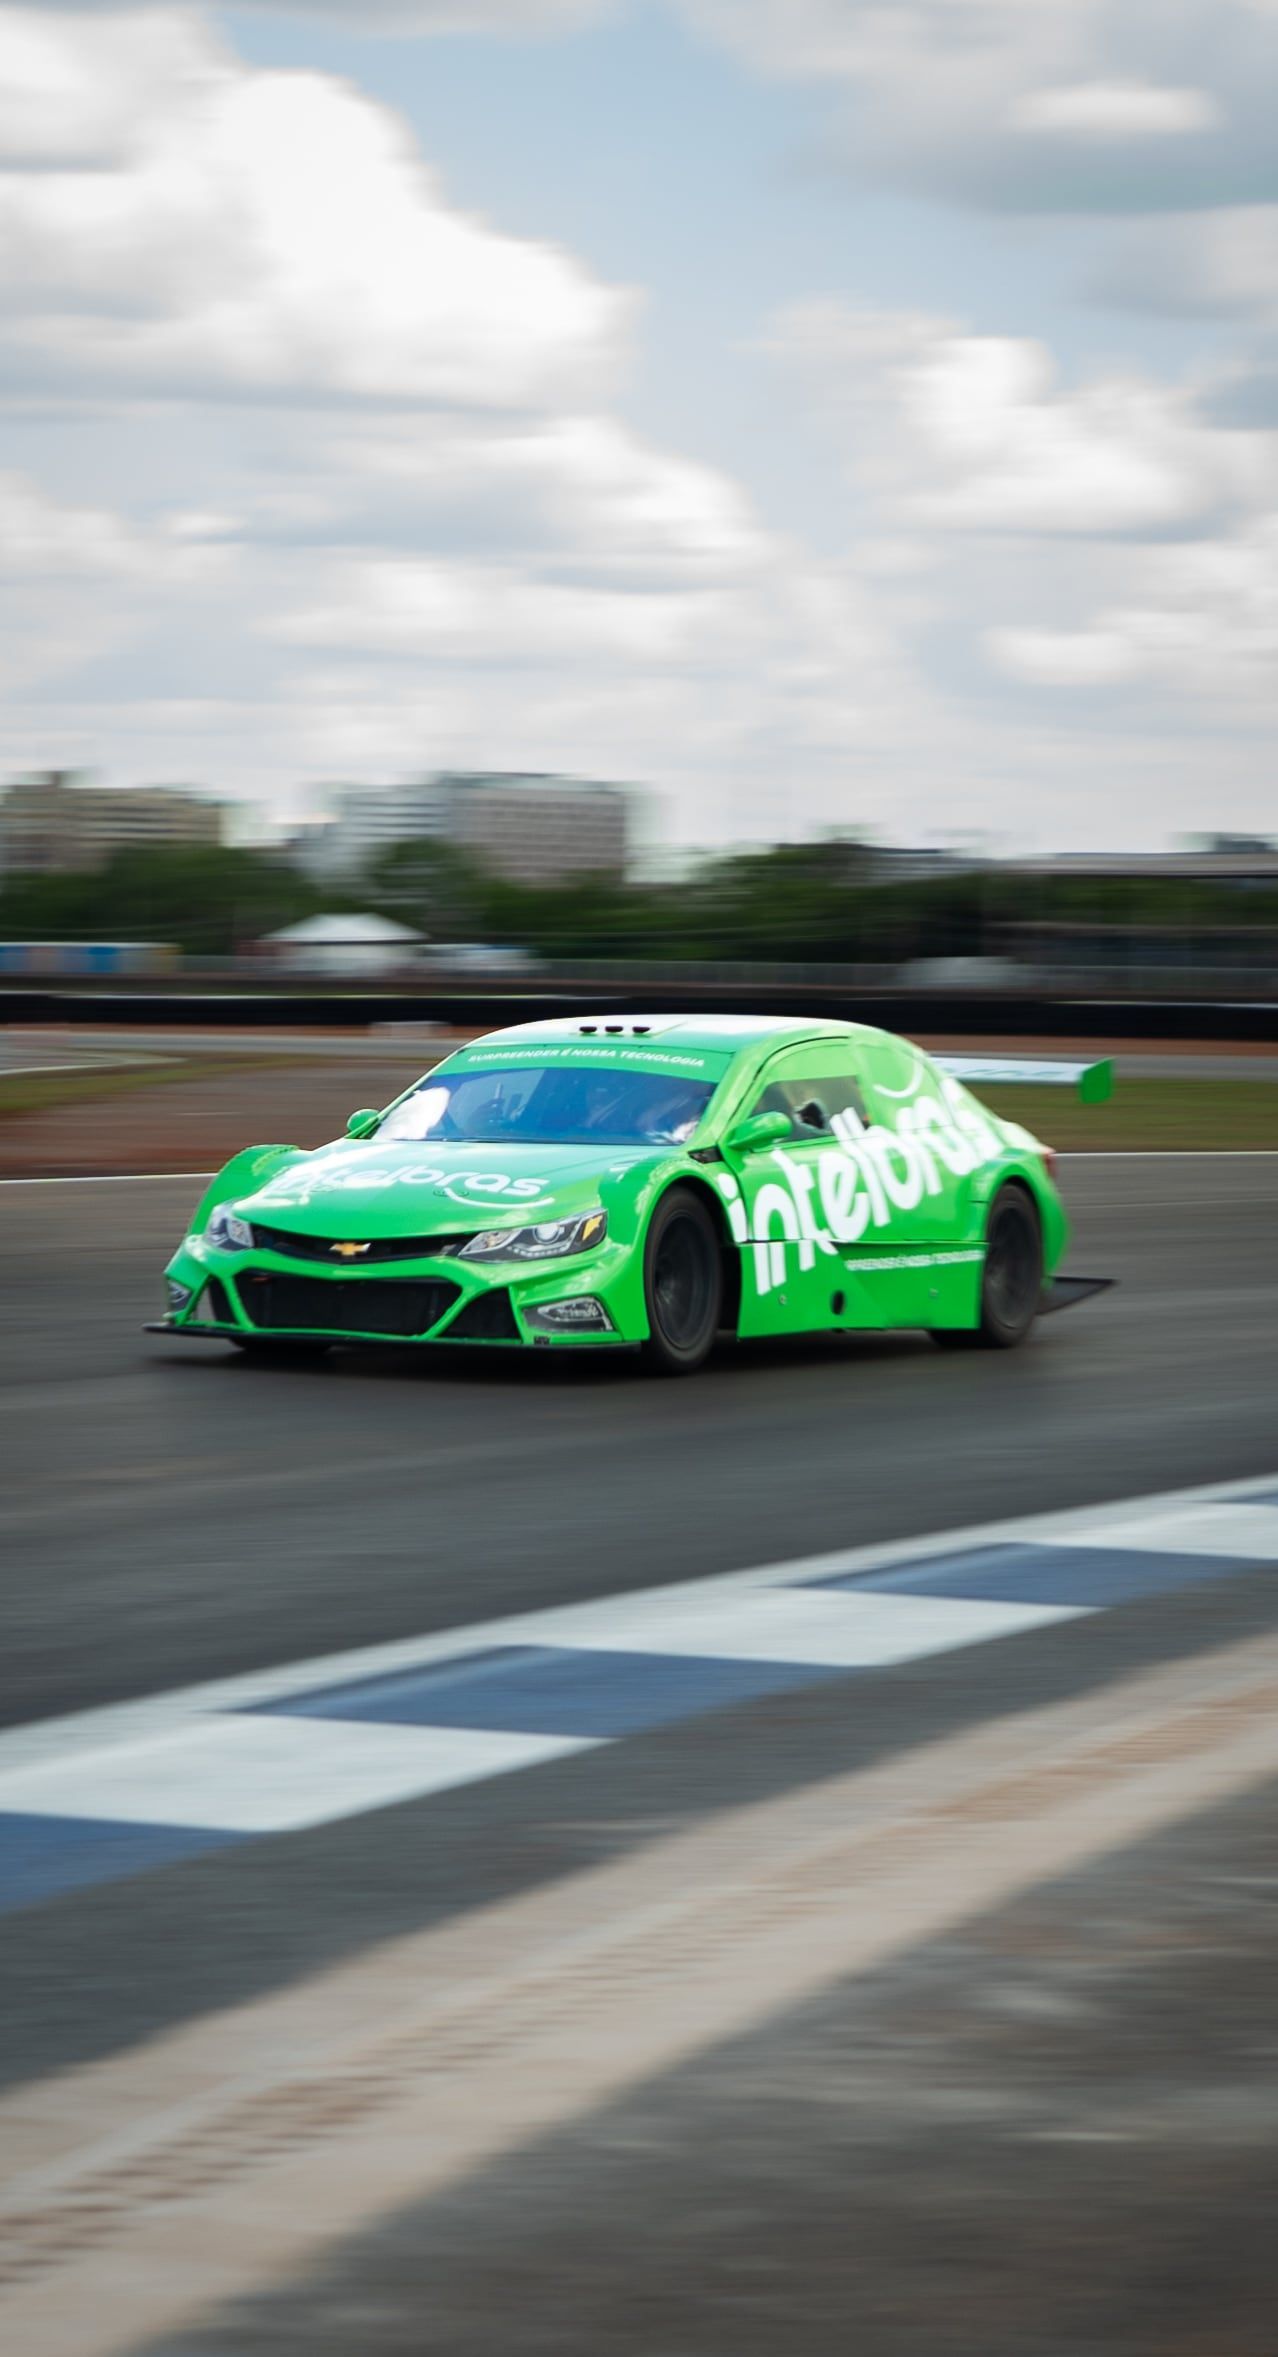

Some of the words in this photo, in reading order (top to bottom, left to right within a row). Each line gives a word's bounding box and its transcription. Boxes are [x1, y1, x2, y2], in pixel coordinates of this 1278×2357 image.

[571, 1049, 616, 1057] NOSSA
[620, 1050, 704, 1067] TECNOLOGIA
[717, 1077, 1004, 1296] intelbras
